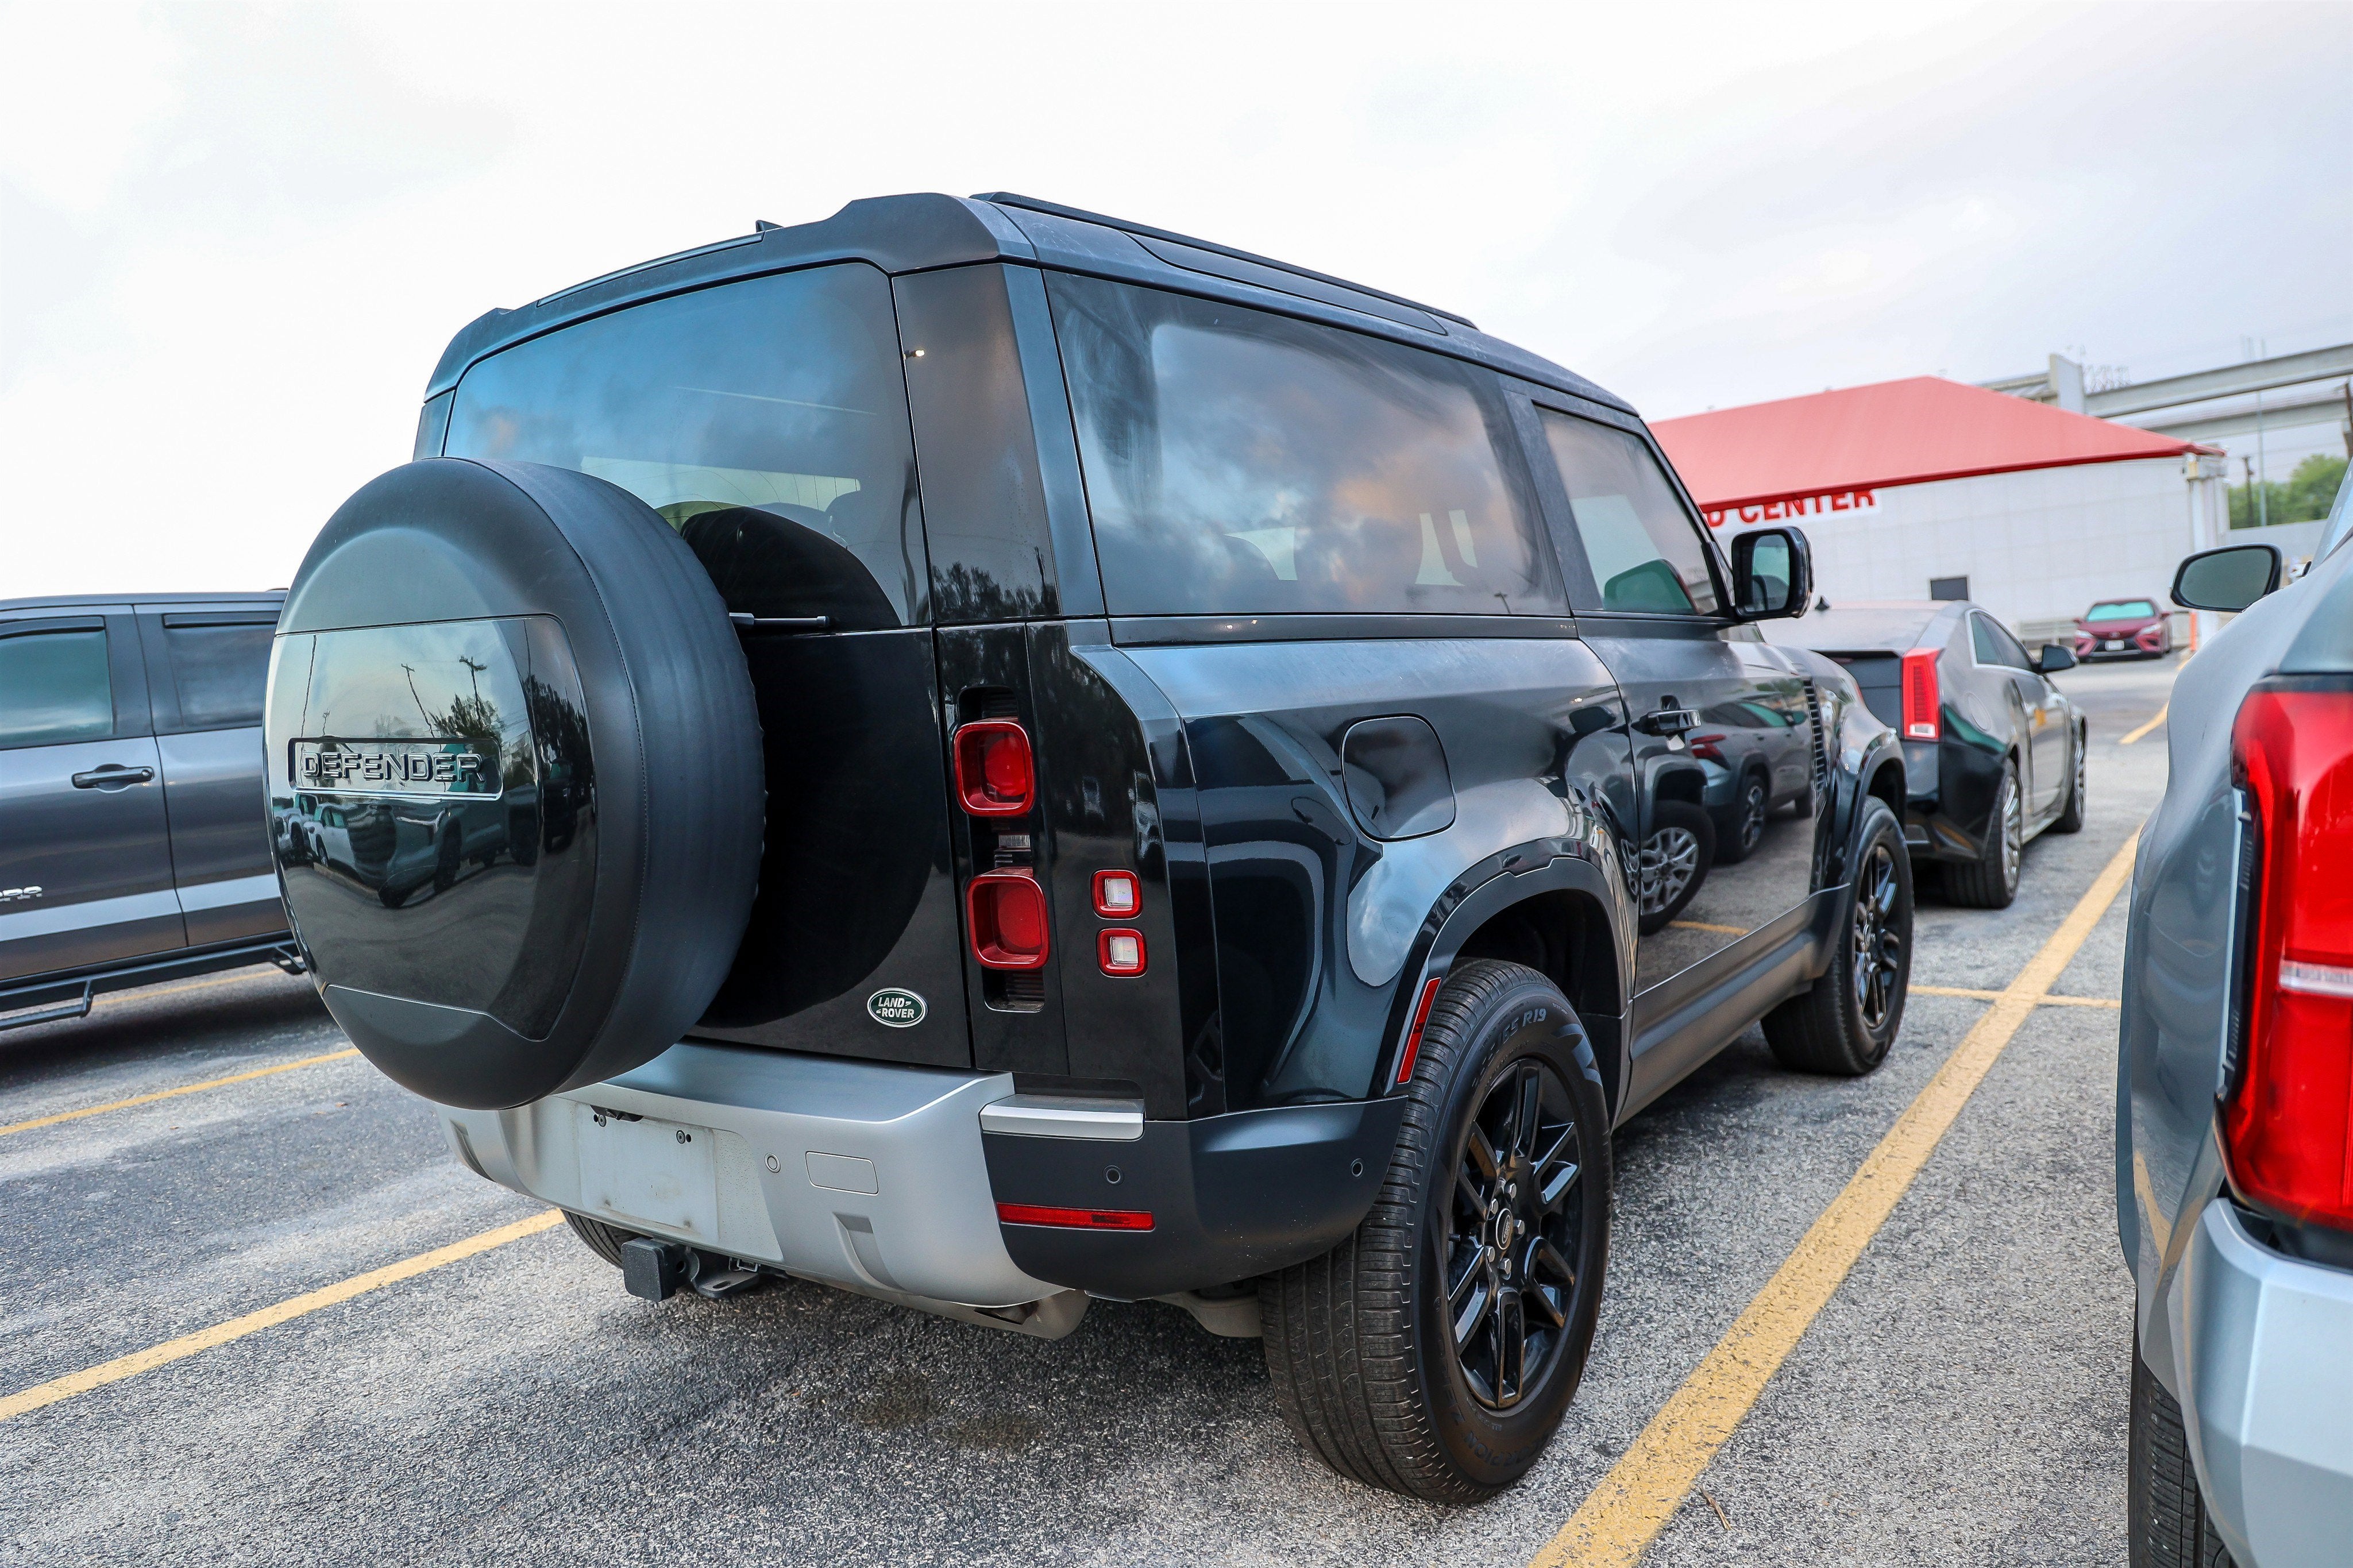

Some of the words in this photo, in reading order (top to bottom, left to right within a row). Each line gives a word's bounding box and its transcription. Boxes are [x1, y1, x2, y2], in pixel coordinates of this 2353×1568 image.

[1738, 489, 1874, 523] CENTER
[303, 751, 485, 782] DEFENDER
[878, 997, 905, 1007] LAND
[881, 1008, 914, 1018] ROVER
